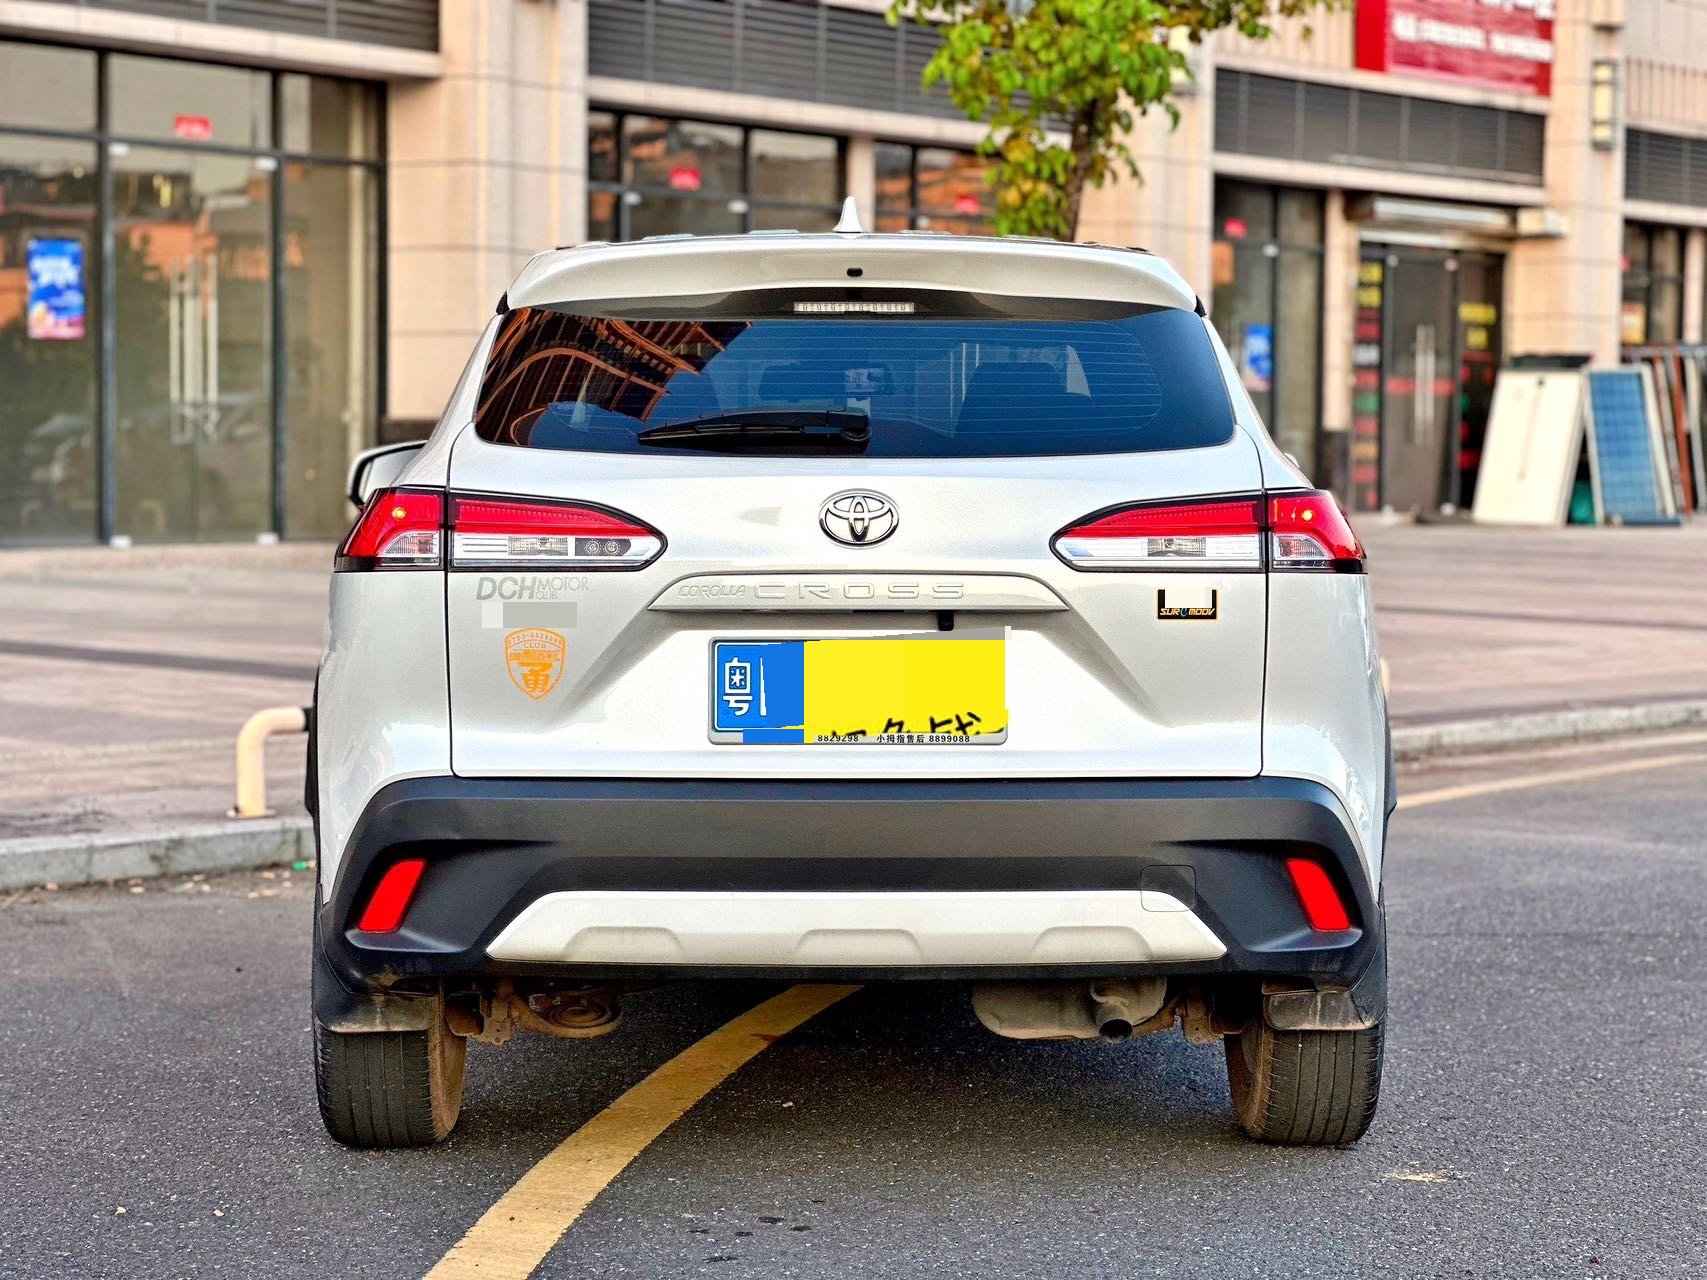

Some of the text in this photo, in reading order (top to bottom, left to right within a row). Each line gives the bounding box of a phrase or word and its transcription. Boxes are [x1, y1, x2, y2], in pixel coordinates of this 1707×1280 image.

[476, 576, 538, 601] DCH
[537, 576, 590, 592] MOTOR
[679, 583, 965, 600] COROLLA CROSS
[722, 656, 754, 717] 粤
[817, 733, 971, 744] 8829298 小拇指售后 8899088
